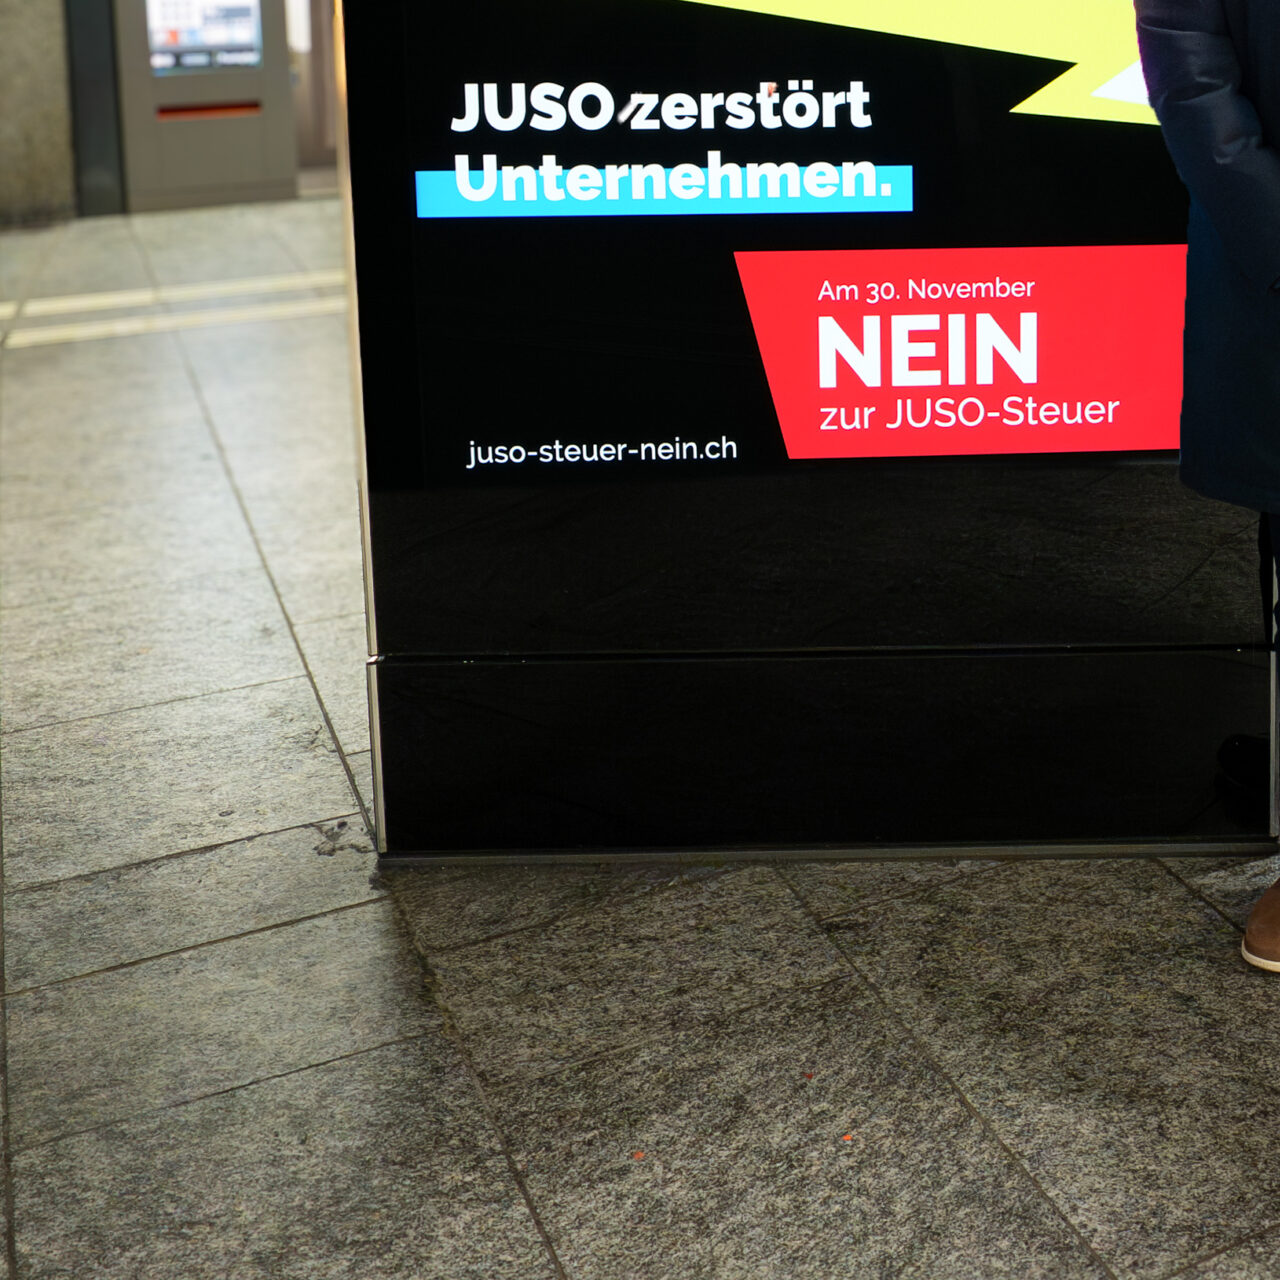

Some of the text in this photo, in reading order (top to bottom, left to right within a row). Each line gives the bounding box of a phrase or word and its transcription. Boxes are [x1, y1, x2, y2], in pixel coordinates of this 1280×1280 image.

[451, 80, 873, 132] JUSO zerstört
[454, 150, 893, 203] Unternehmen.
[818, 277, 1036, 304] Am 30. November
[818, 312, 1038, 389] NEIN
[819, 396, 1120, 430] zur JUSO-Steuer
[465, 435, 737, 469] juso-steuer-nein.ch
